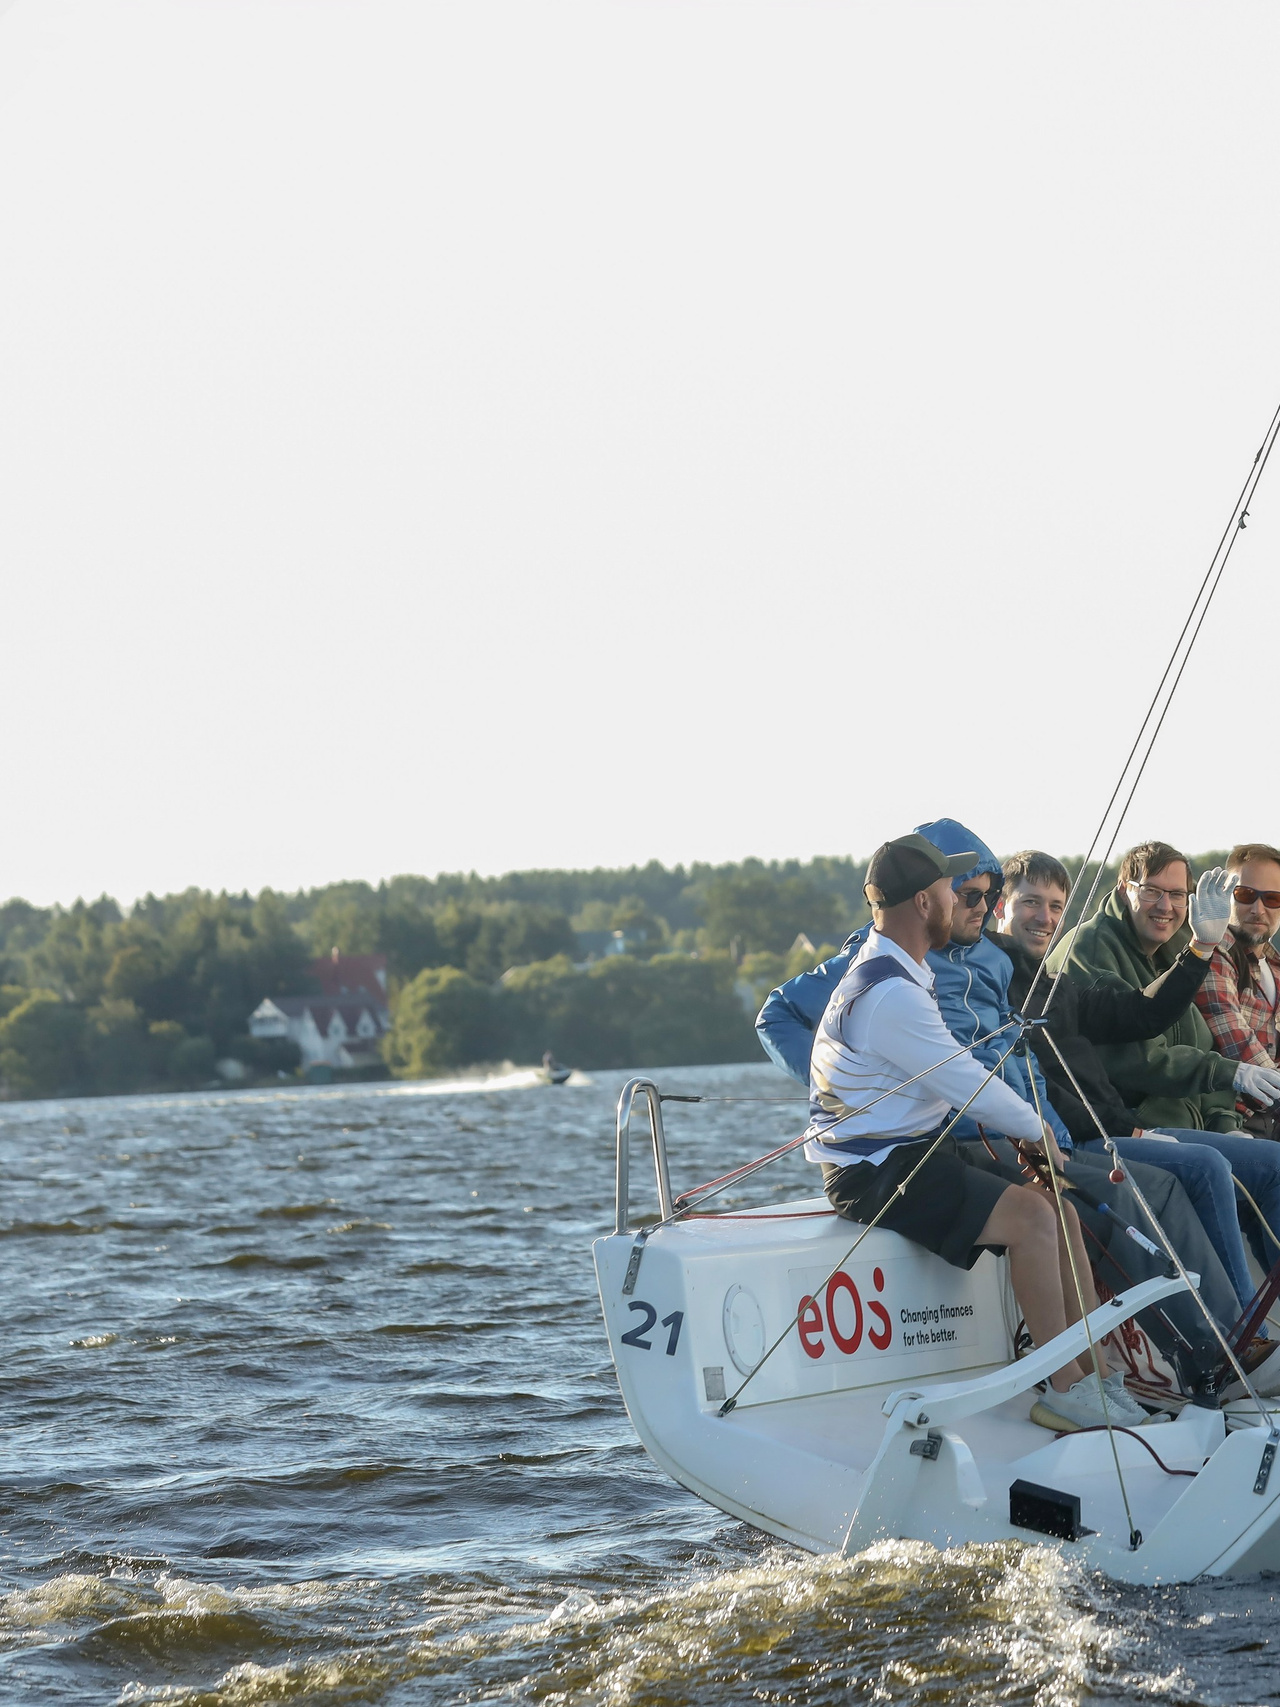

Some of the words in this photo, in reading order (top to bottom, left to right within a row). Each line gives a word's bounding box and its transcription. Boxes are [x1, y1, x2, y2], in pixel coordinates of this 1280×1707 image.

[901, 1306, 940, 1325] Changing
[940, 1304, 973, 1319] finances
[621, 1301, 684, 1356] 21
[903, 1332, 915, 1346] for
[916, 1330, 930, 1344] the
[930, 1329, 957, 1343] better.
